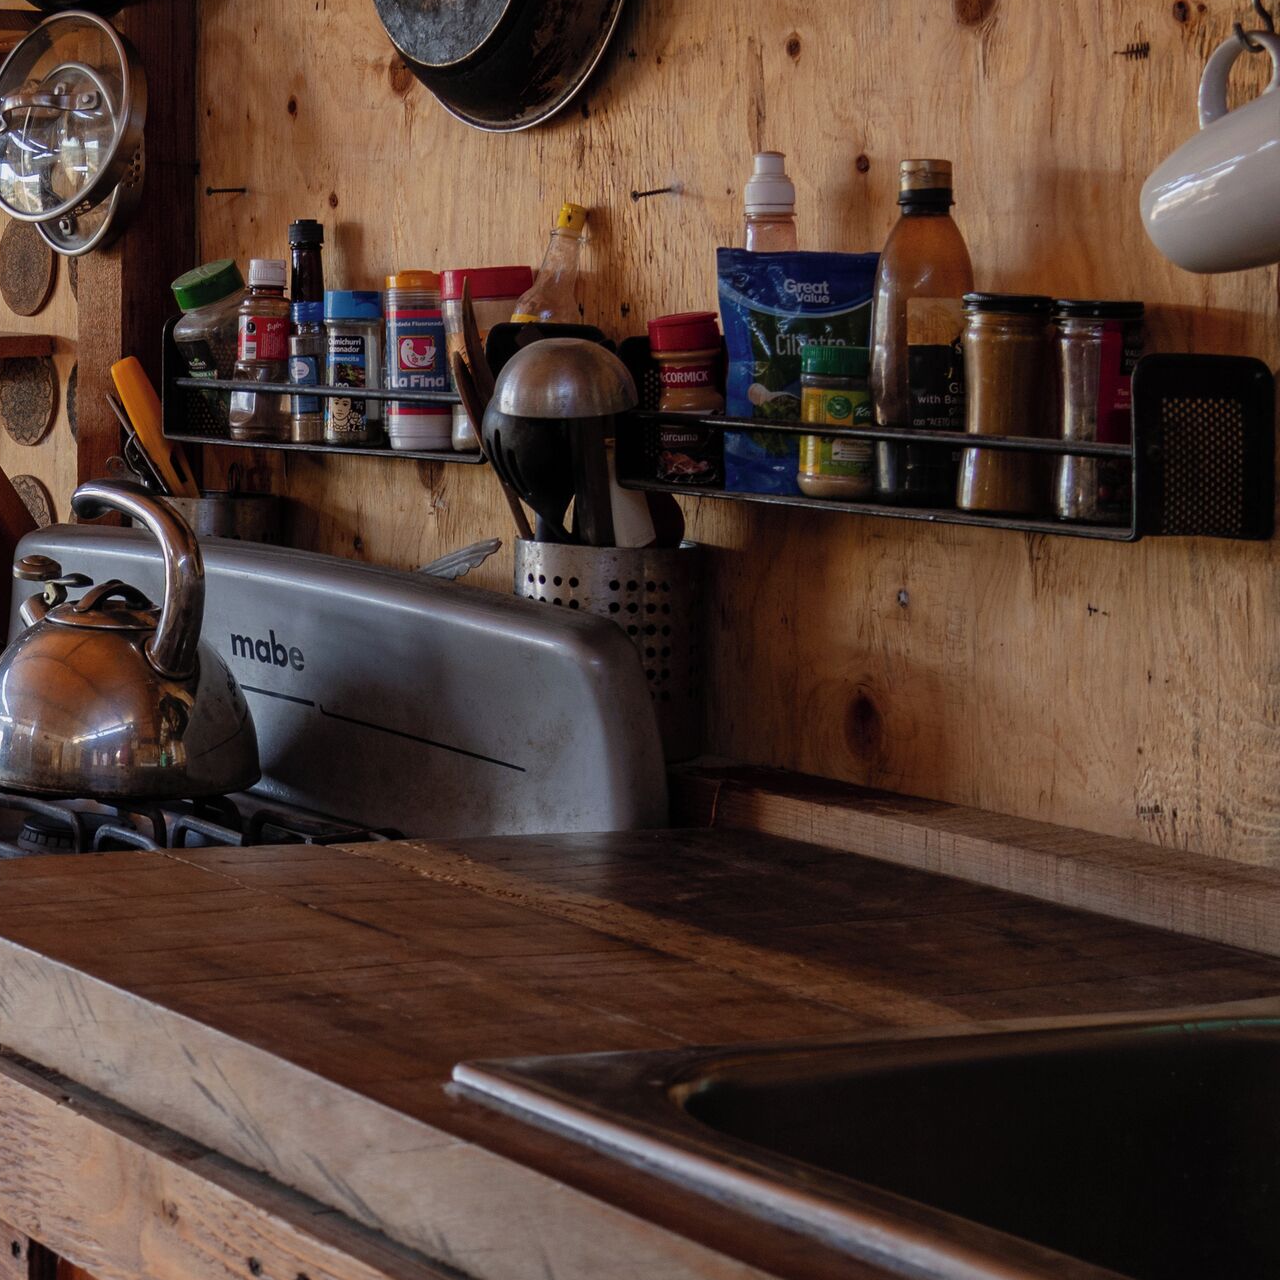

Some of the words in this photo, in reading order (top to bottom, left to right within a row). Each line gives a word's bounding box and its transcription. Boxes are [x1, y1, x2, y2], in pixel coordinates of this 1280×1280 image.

[783, 278, 830, 295] Great
[795, 293, 831, 304] Value
[327, 337, 362, 346] Cmichurri
[391, 375, 409, 388] La
[410, 374, 445, 388] Fina
[917, 394, 941, 405] with
[231, 629, 305, 671] mabe
